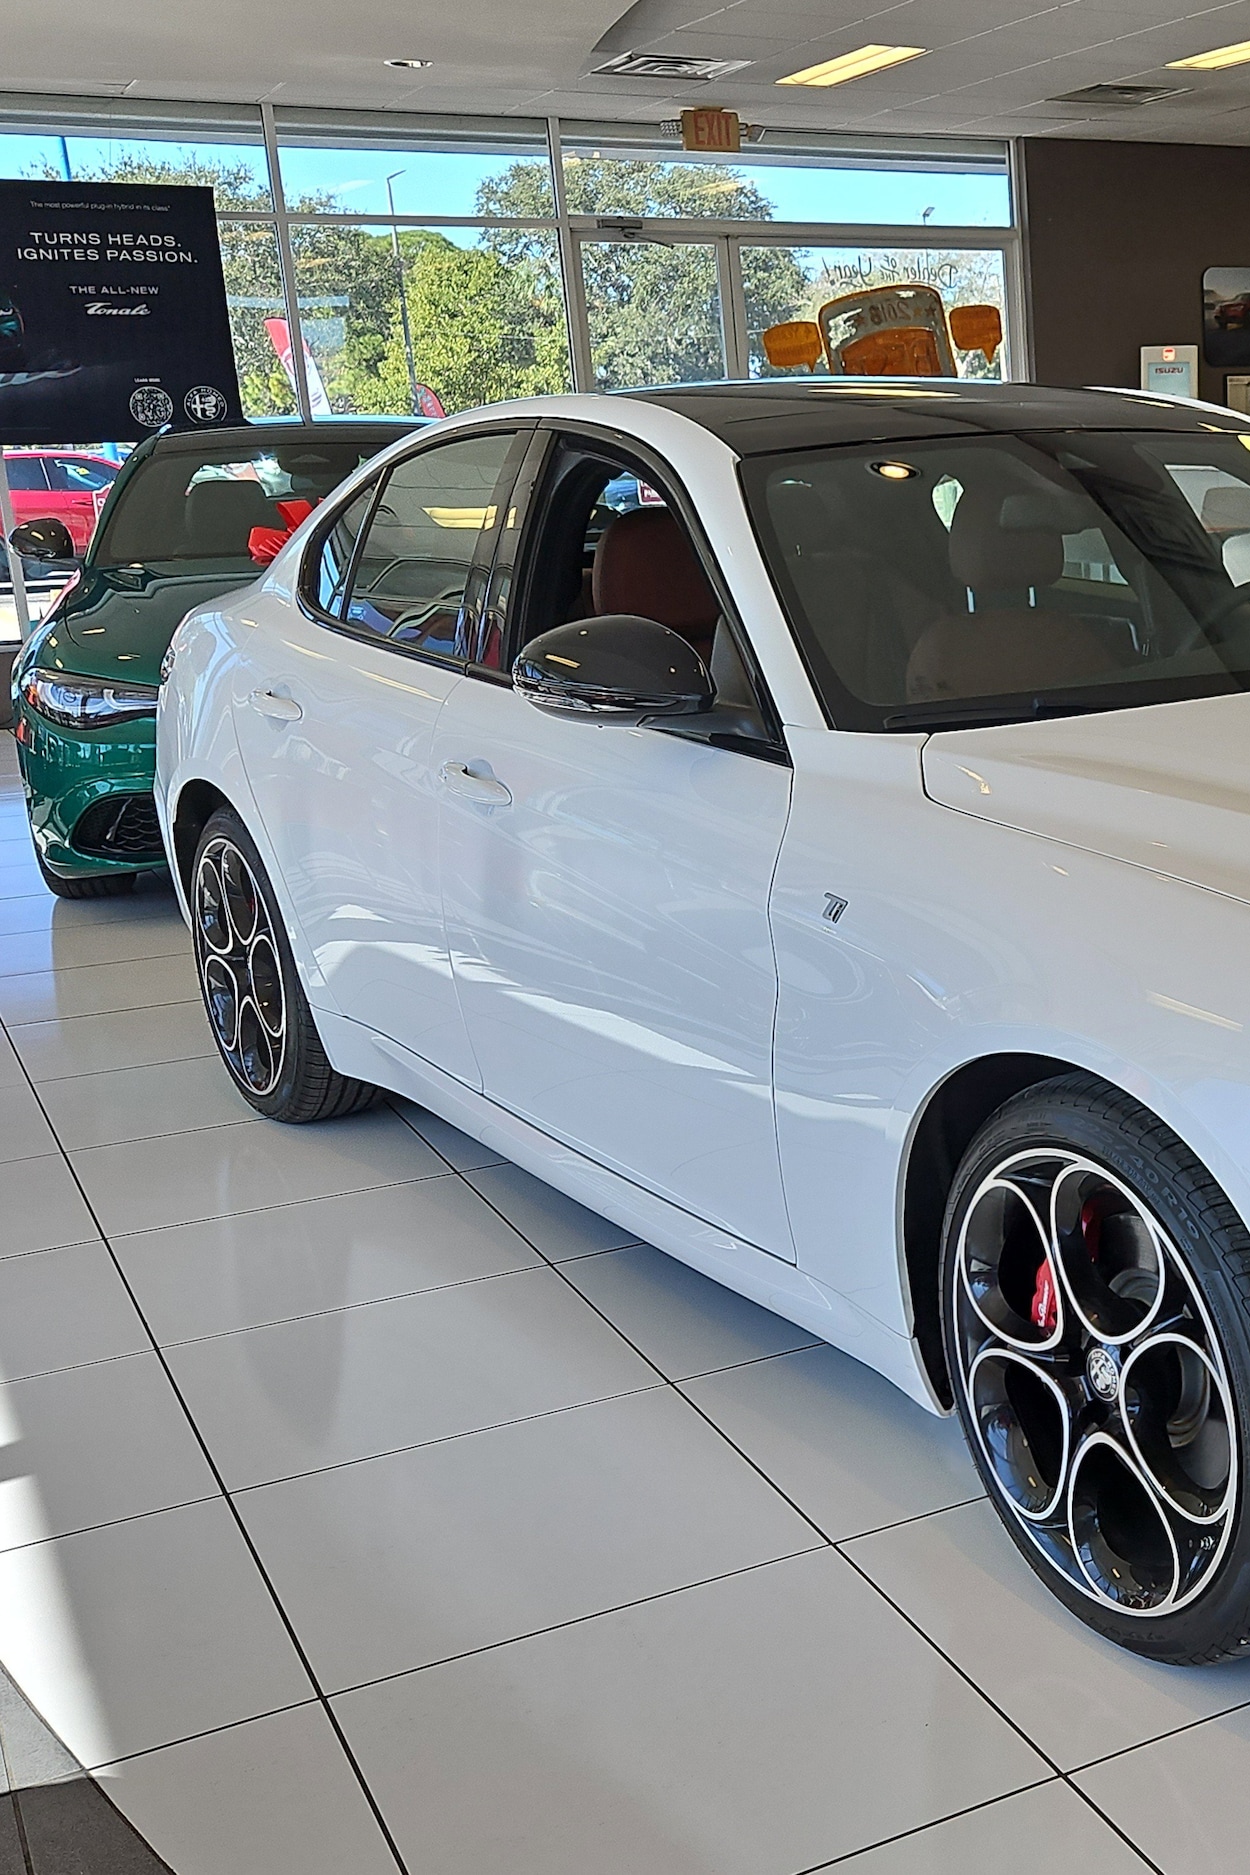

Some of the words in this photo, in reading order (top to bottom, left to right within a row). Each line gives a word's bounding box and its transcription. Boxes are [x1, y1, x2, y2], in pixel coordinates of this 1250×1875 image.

[693, 112, 733, 147] EXIT
[30, 200, 43, 208] The
[61, 202, 90, 211] powerful
[90, 203, 113, 211] plug-in
[113, 203, 135, 212] hybrid
[29, 231, 101, 246] TURNS
[107, 233, 182, 248] HEADS.
[17, 247, 100, 261] IGNITES
[106, 249, 199, 264] PASSION.
[69, 285, 97, 295] THE
[100, 285, 159, 295] ALL-NEW
[84, 302, 151, 316] Tonale
